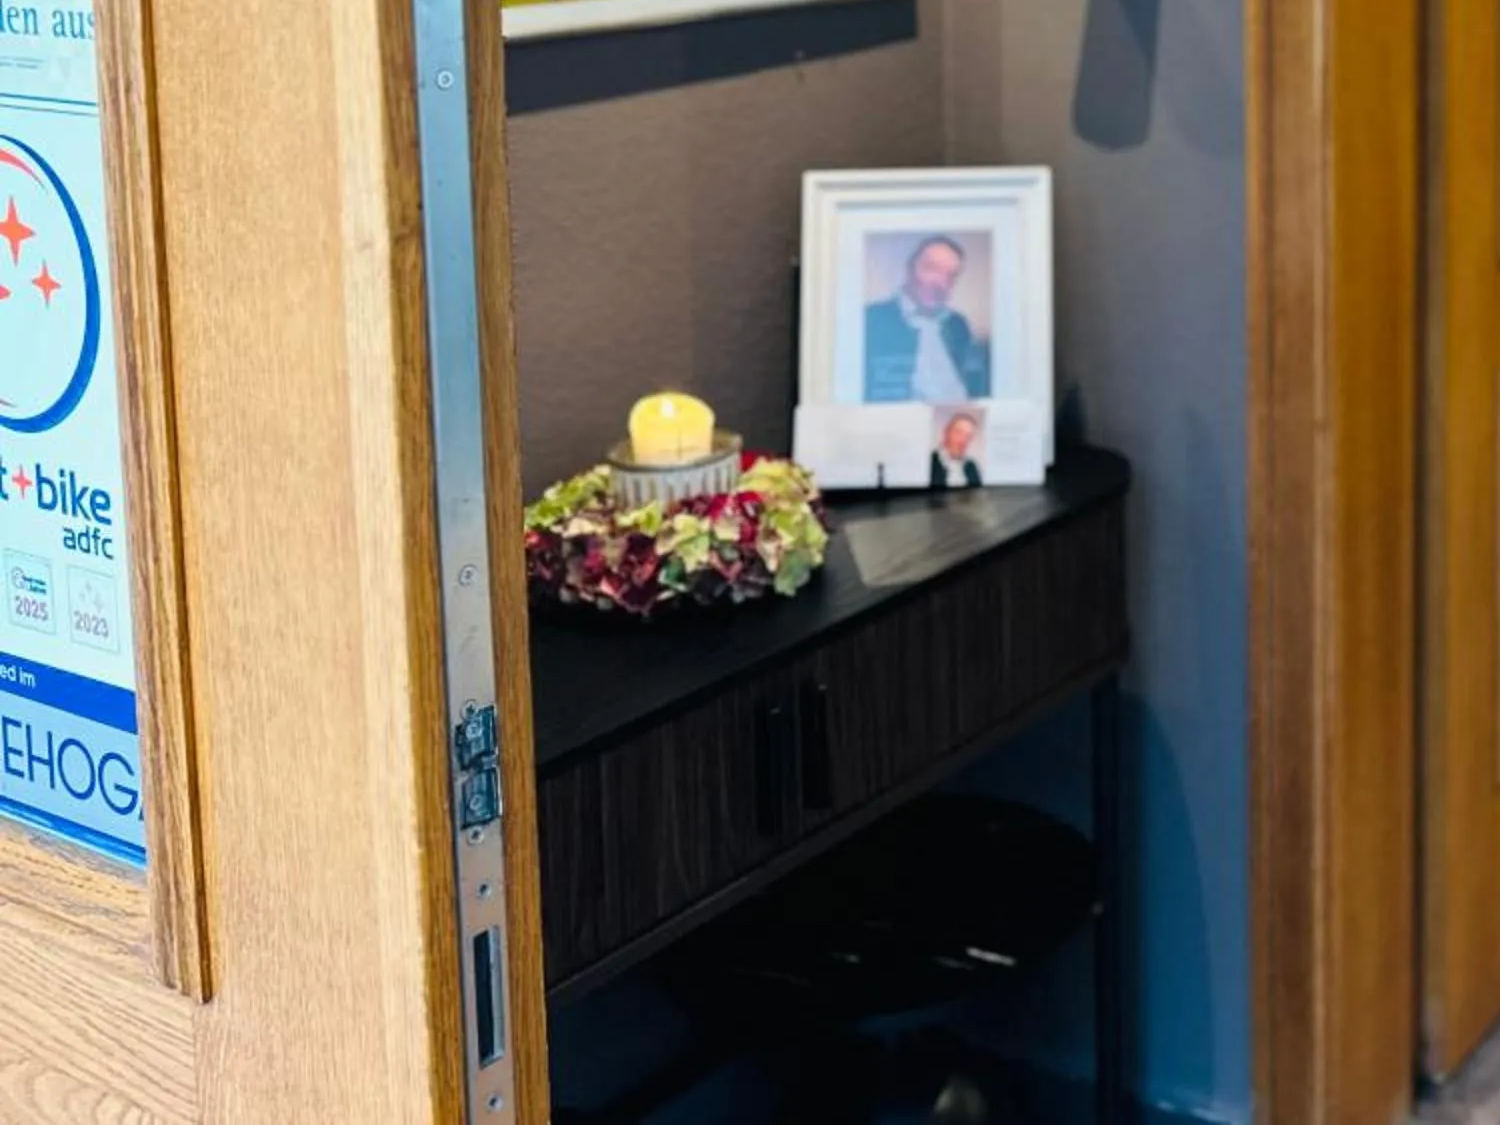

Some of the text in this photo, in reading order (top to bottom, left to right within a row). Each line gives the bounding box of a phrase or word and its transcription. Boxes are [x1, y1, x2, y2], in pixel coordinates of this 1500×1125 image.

[63, 525, 114, 561] adfc
[15, 595, 49, 621] 2025
[2, 715, 144, 821] EHOG
